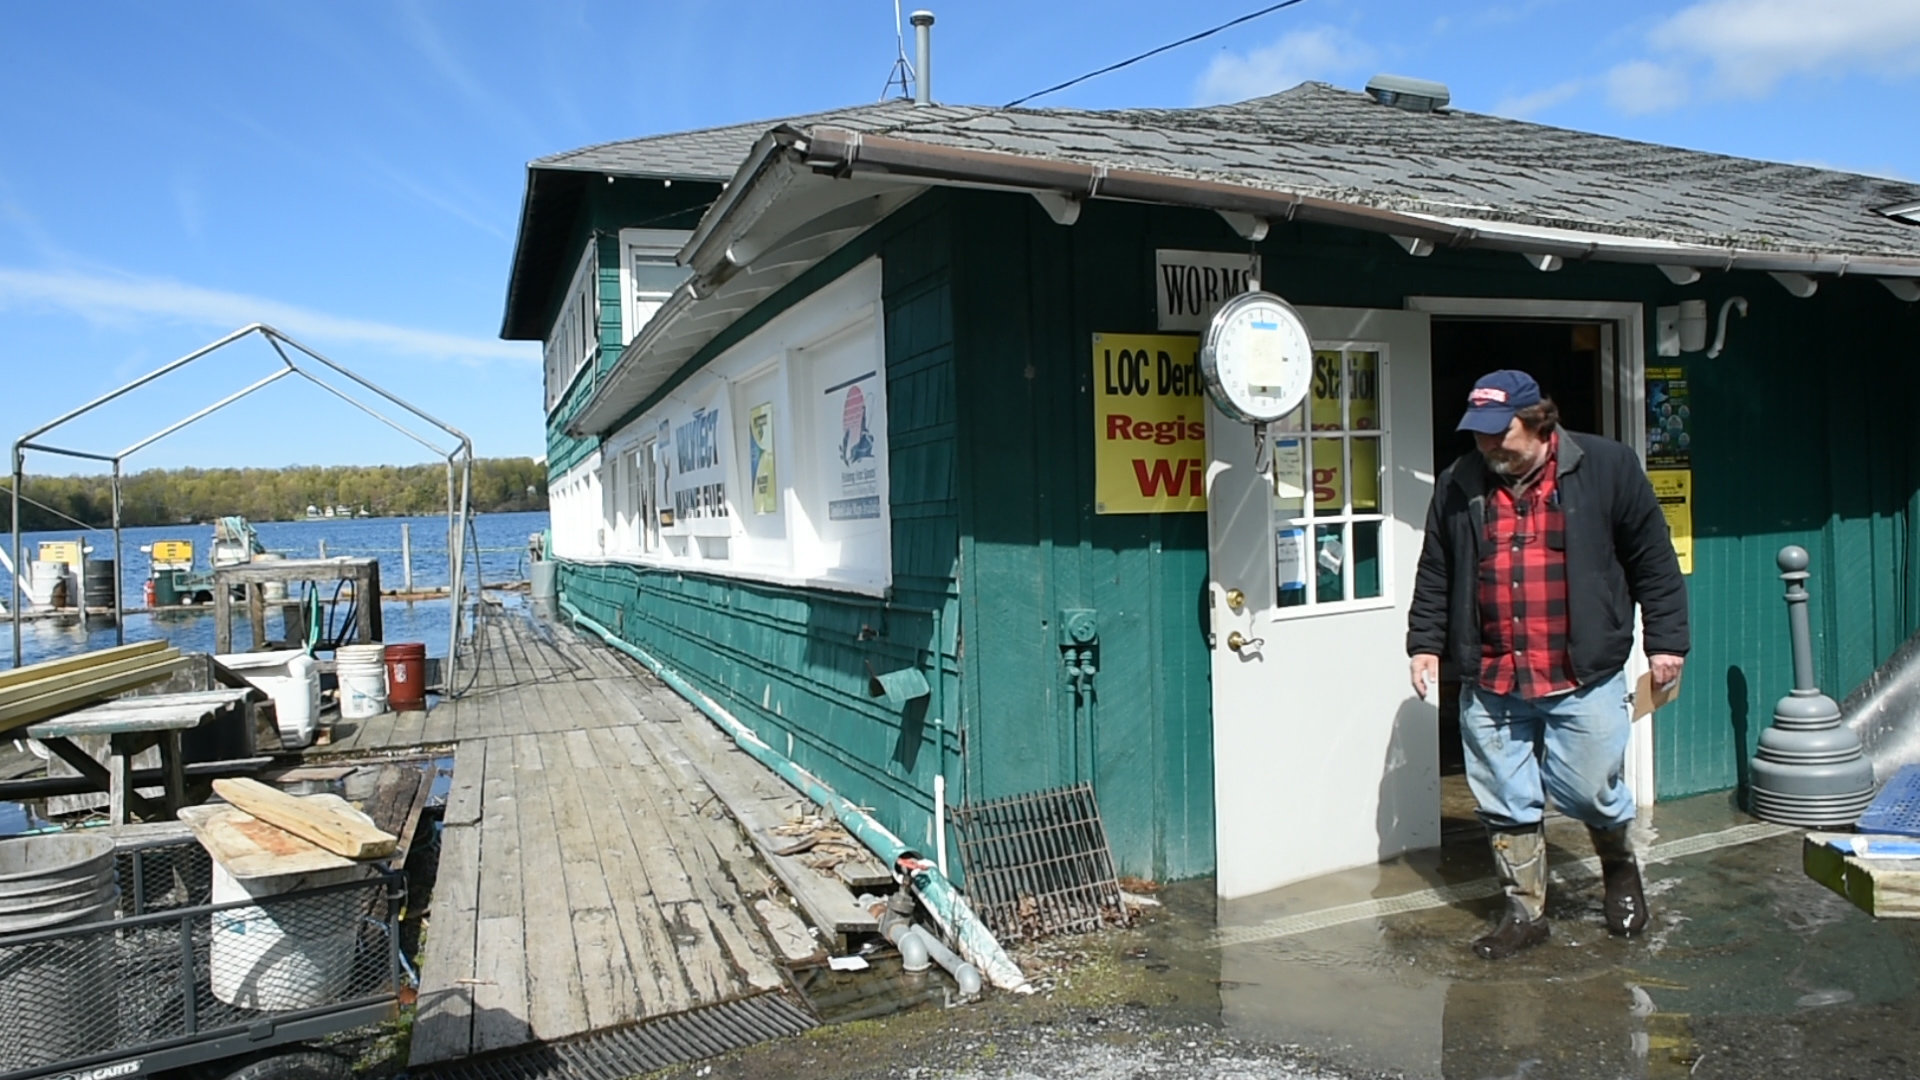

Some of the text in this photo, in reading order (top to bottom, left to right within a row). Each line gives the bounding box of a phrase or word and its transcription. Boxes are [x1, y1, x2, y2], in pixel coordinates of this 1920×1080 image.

[1104, 348, 1150, 396] LOC
[1157, 350, 1204, 397] Derb
[1106, 414, 1205, 445] Regis
[1131, 458, 1202, 498] Wi
[703, 482, 729, 518] FUEL
